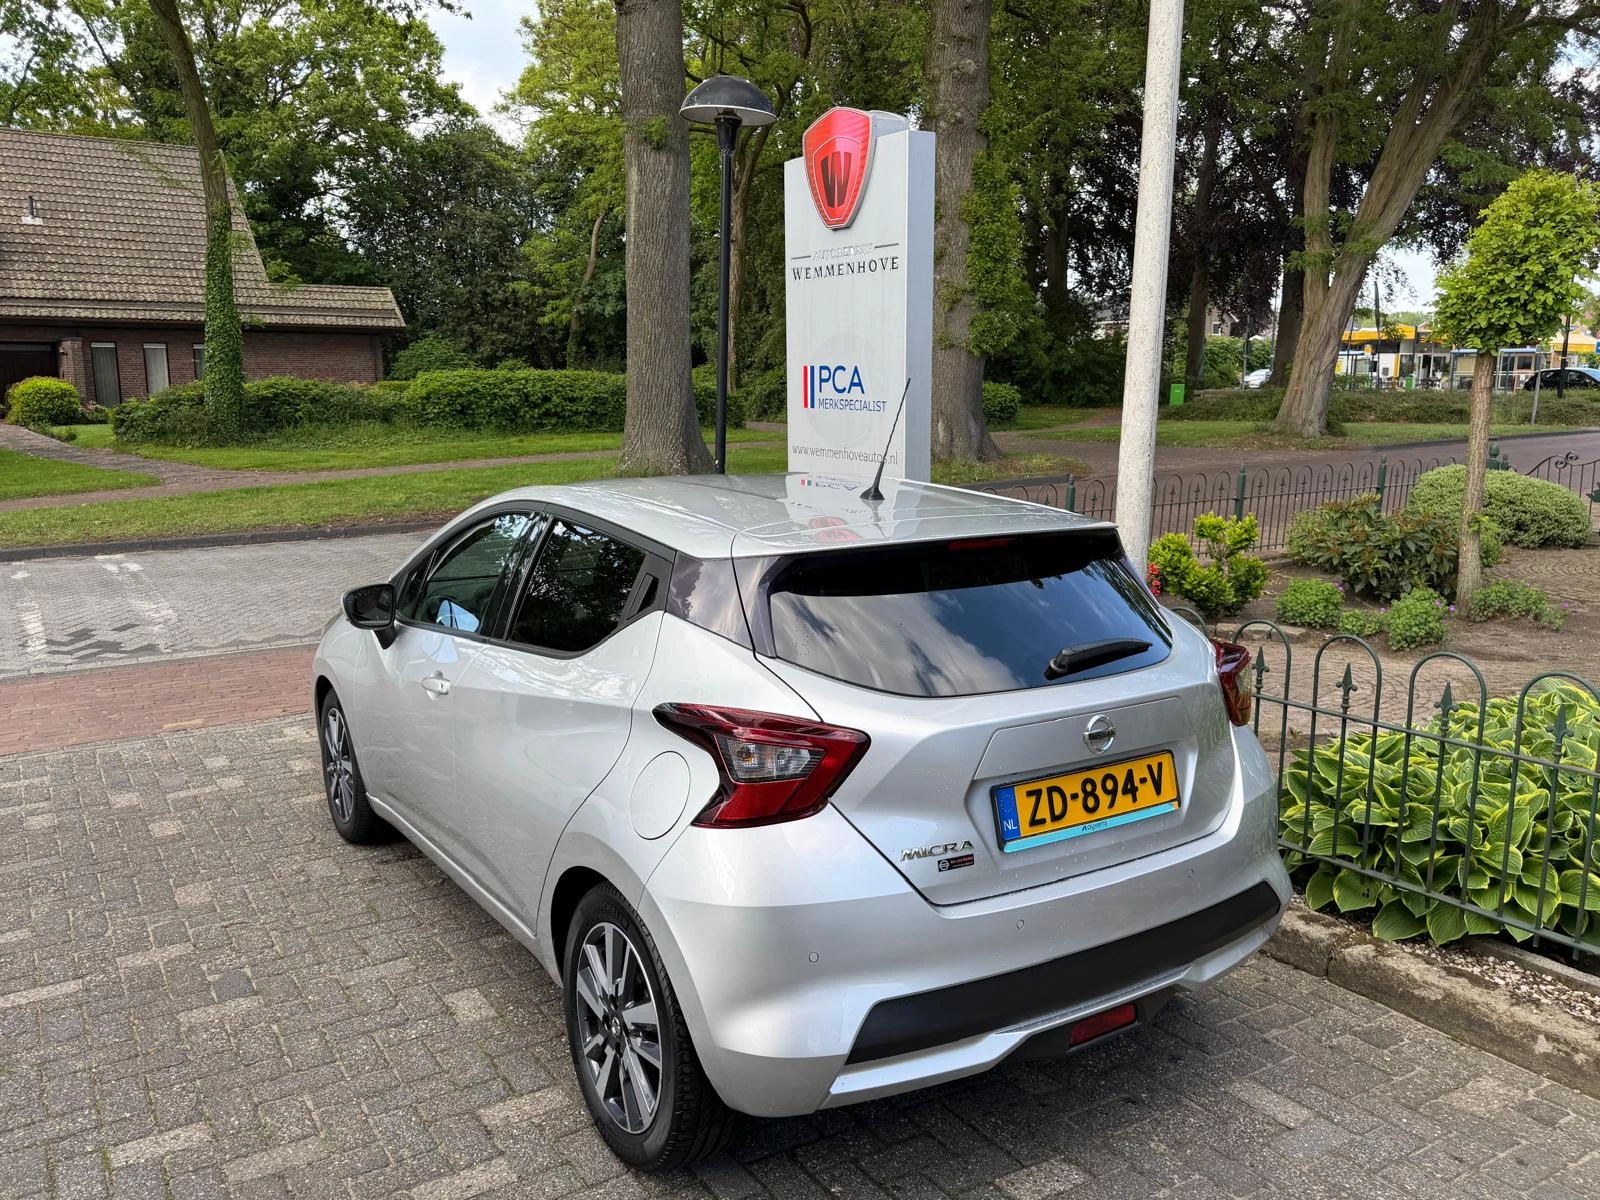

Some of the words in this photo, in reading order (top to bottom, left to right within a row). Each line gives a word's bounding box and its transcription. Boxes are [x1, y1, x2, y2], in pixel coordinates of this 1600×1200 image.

[792, 256, 899, 281] WEMMENHOVE
[818, 365, 865, 394] PCA
[818, 398, 887, 412] MERKSPECIALIST
[792, 444, 898, 465] www.wemmenhoveautos.nl
[1025, 761, 1163, 828] ZD-894-V
[1003, 820, 1018, 832] NL
[901, 839, 975, 861] MICRA
